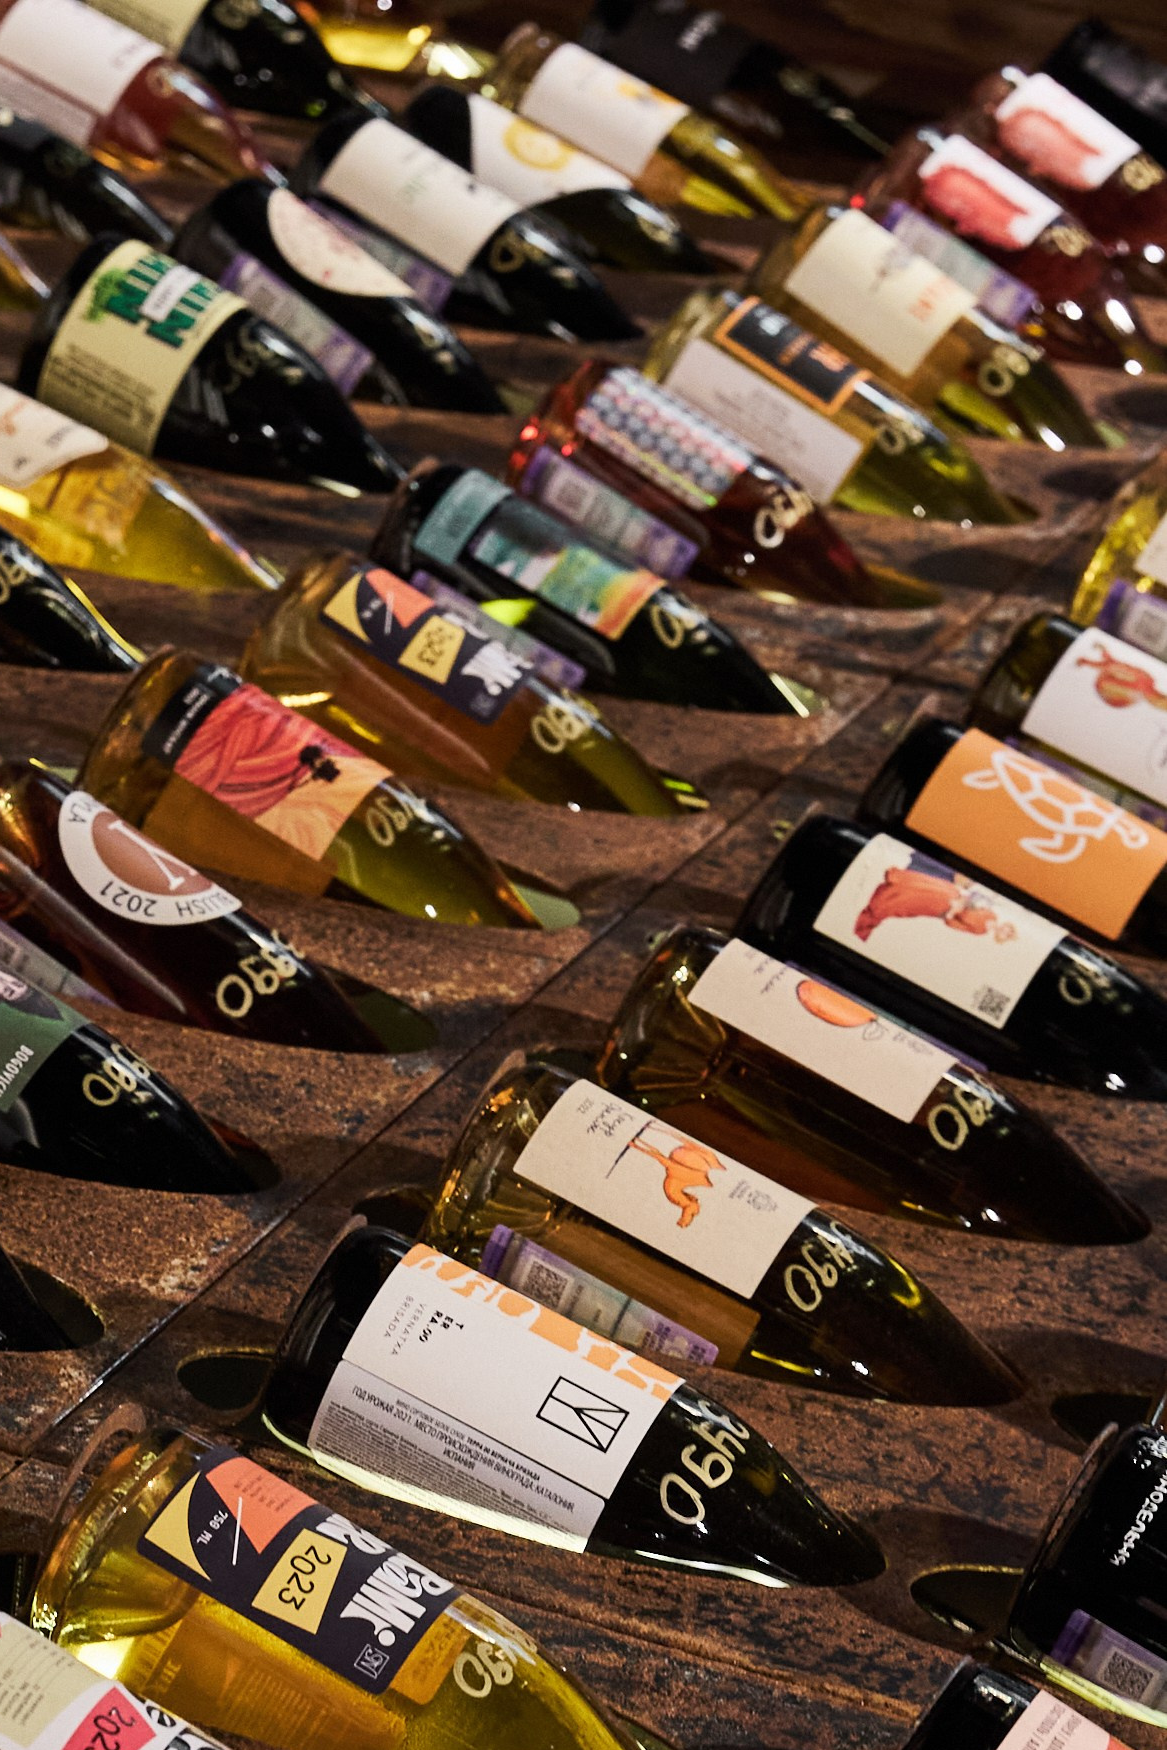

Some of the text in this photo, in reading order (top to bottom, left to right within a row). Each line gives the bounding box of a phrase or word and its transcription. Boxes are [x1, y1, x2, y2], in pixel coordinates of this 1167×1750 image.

[98, 879, 159, 918] 2021
[382, 1293, 413, 1339] BRISADA
[389, 1301, 427, 1357] VERNATXA
[439, 1315, 453, 1330] ER
[351, 1385, 369, 1400] ГОД
[413, 1418, 438, 1437] МЕСТО
[653, 1397, 754, 1530] 3490
[195, 1509, 228, 1547] 750 ML
[274, 1543, 333, 1611] 2023
